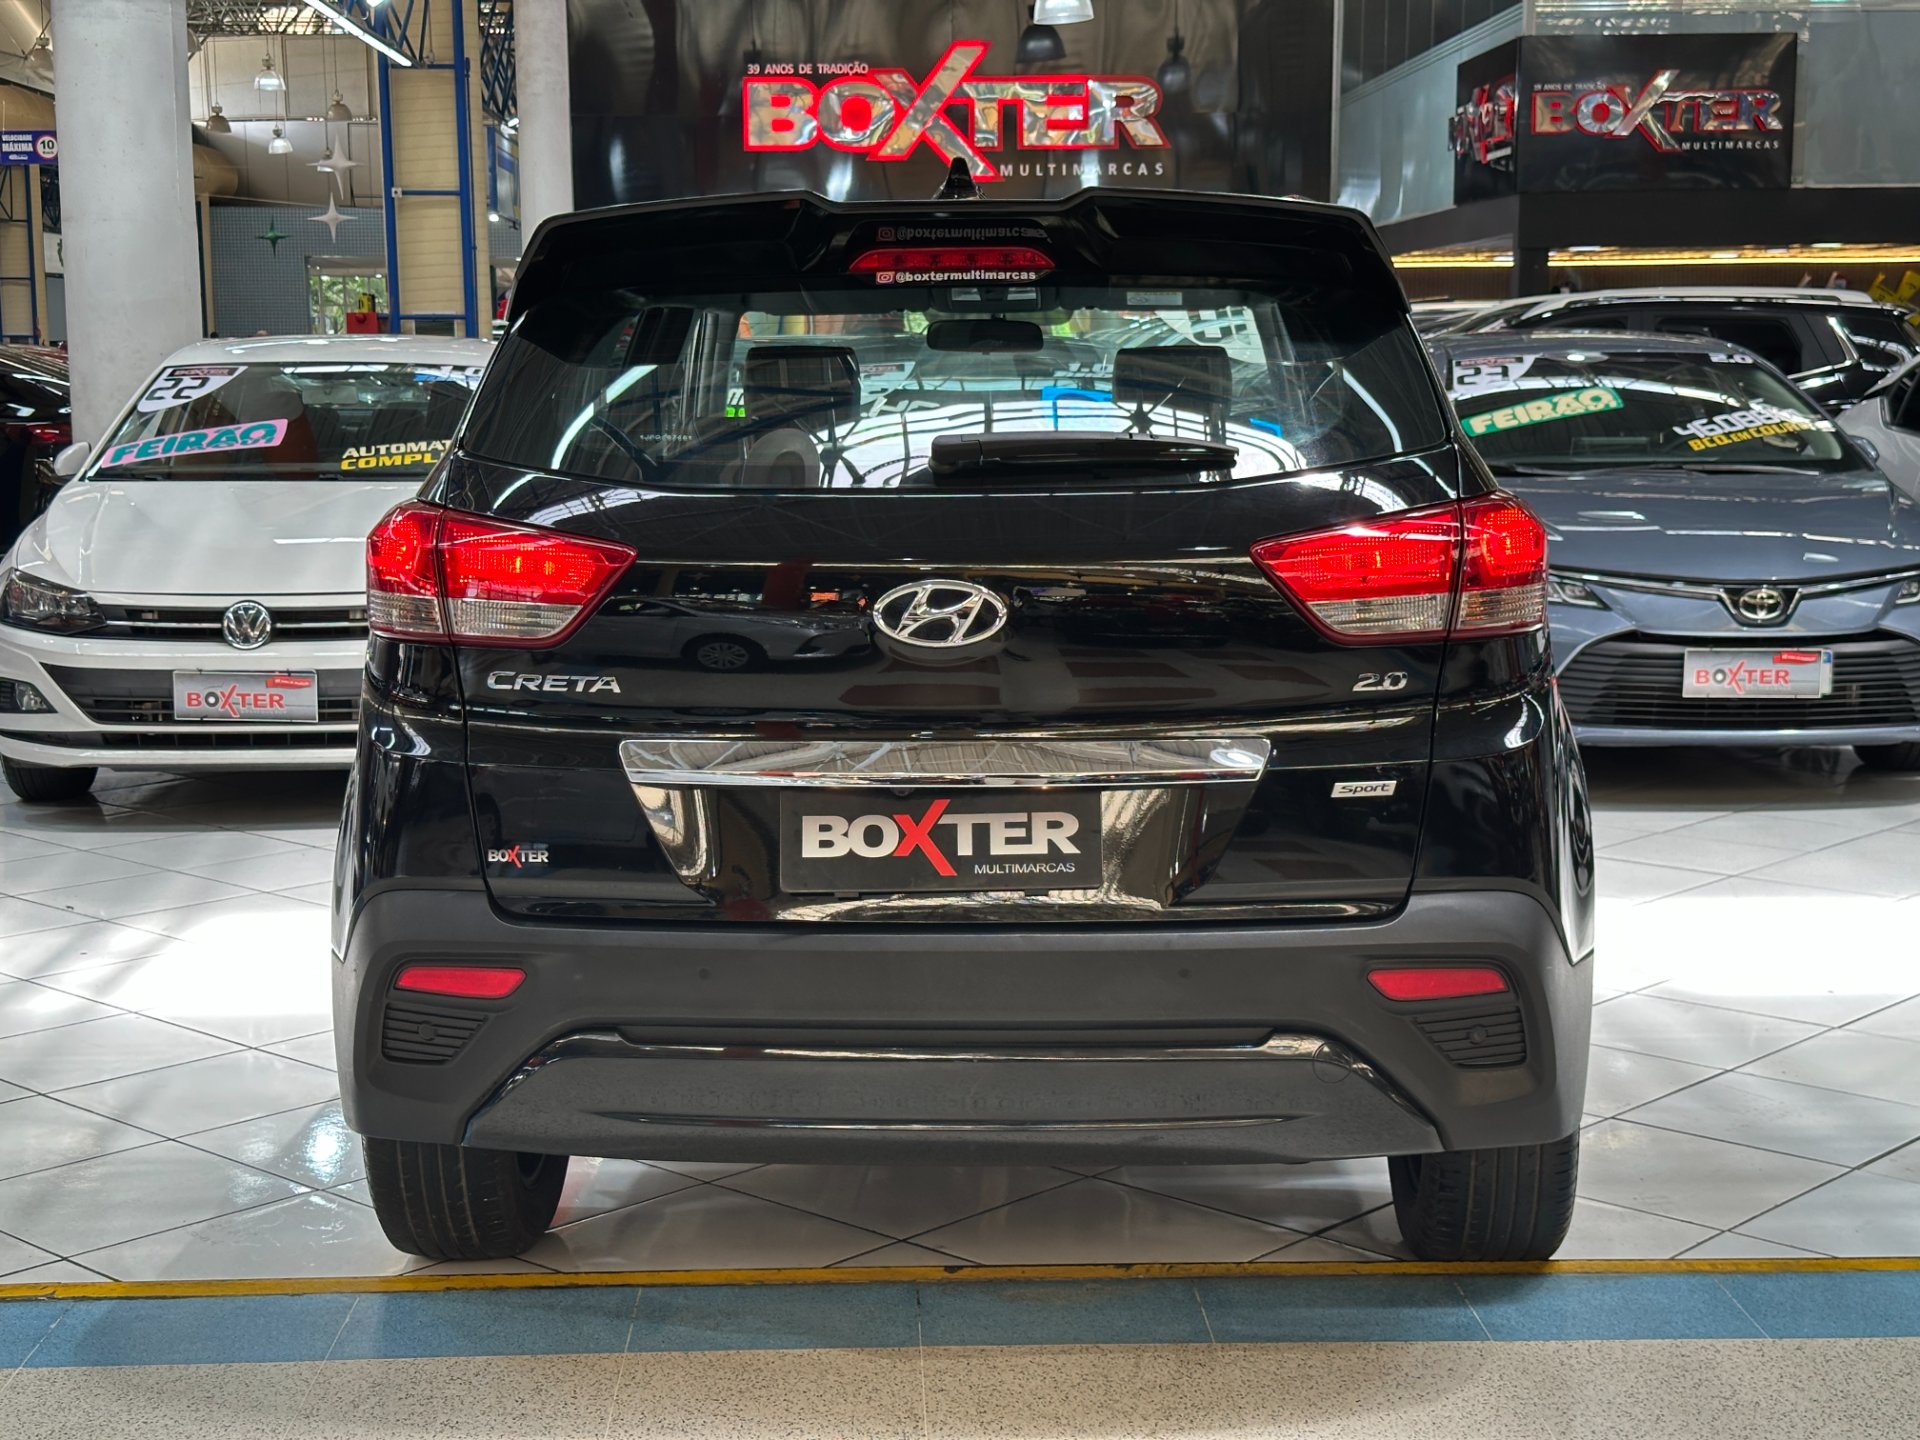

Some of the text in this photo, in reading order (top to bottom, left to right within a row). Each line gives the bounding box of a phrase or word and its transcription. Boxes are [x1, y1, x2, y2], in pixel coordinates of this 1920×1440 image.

[747, 61, 869, 76] 39 ANOS DE TRADIÇÃO
[743, 40, 1172, 182] BOXTER
[1531, 69, 1783, 152] BOXTER
[40, 139, 55, 150] 10
[1682, 141, 1780, 151] MULTIMARCAS
[1001, 162, 1165, 177] MULTIMARCAS
[896, 271, 1036, 283] @boxtermultimarcas
[1709, 352, 1754, 364] 2.0
[1457, 366, 1510, 385] 23
[145, 377, 210, 401] 22
[1469, 388, 1617, 435] FEIRÃO
[110, 422, 278, 464] FEIRÃO
[1731, 430, 1751, 443] EM
[340, 453, 443, 471] COMPL
[487, 670, 622, 693] CRETA
[1694, 660, 1791, 694] BOXTER
[185, 683, 286, 718] BOXTER
[1338, 783, 1391, 795] Sport
[801, 799, 1082, 877] BOXTER
[488, 845, 549, 869] BOXTER
[974, 862, 1076, 875] MULTIMARCAS
